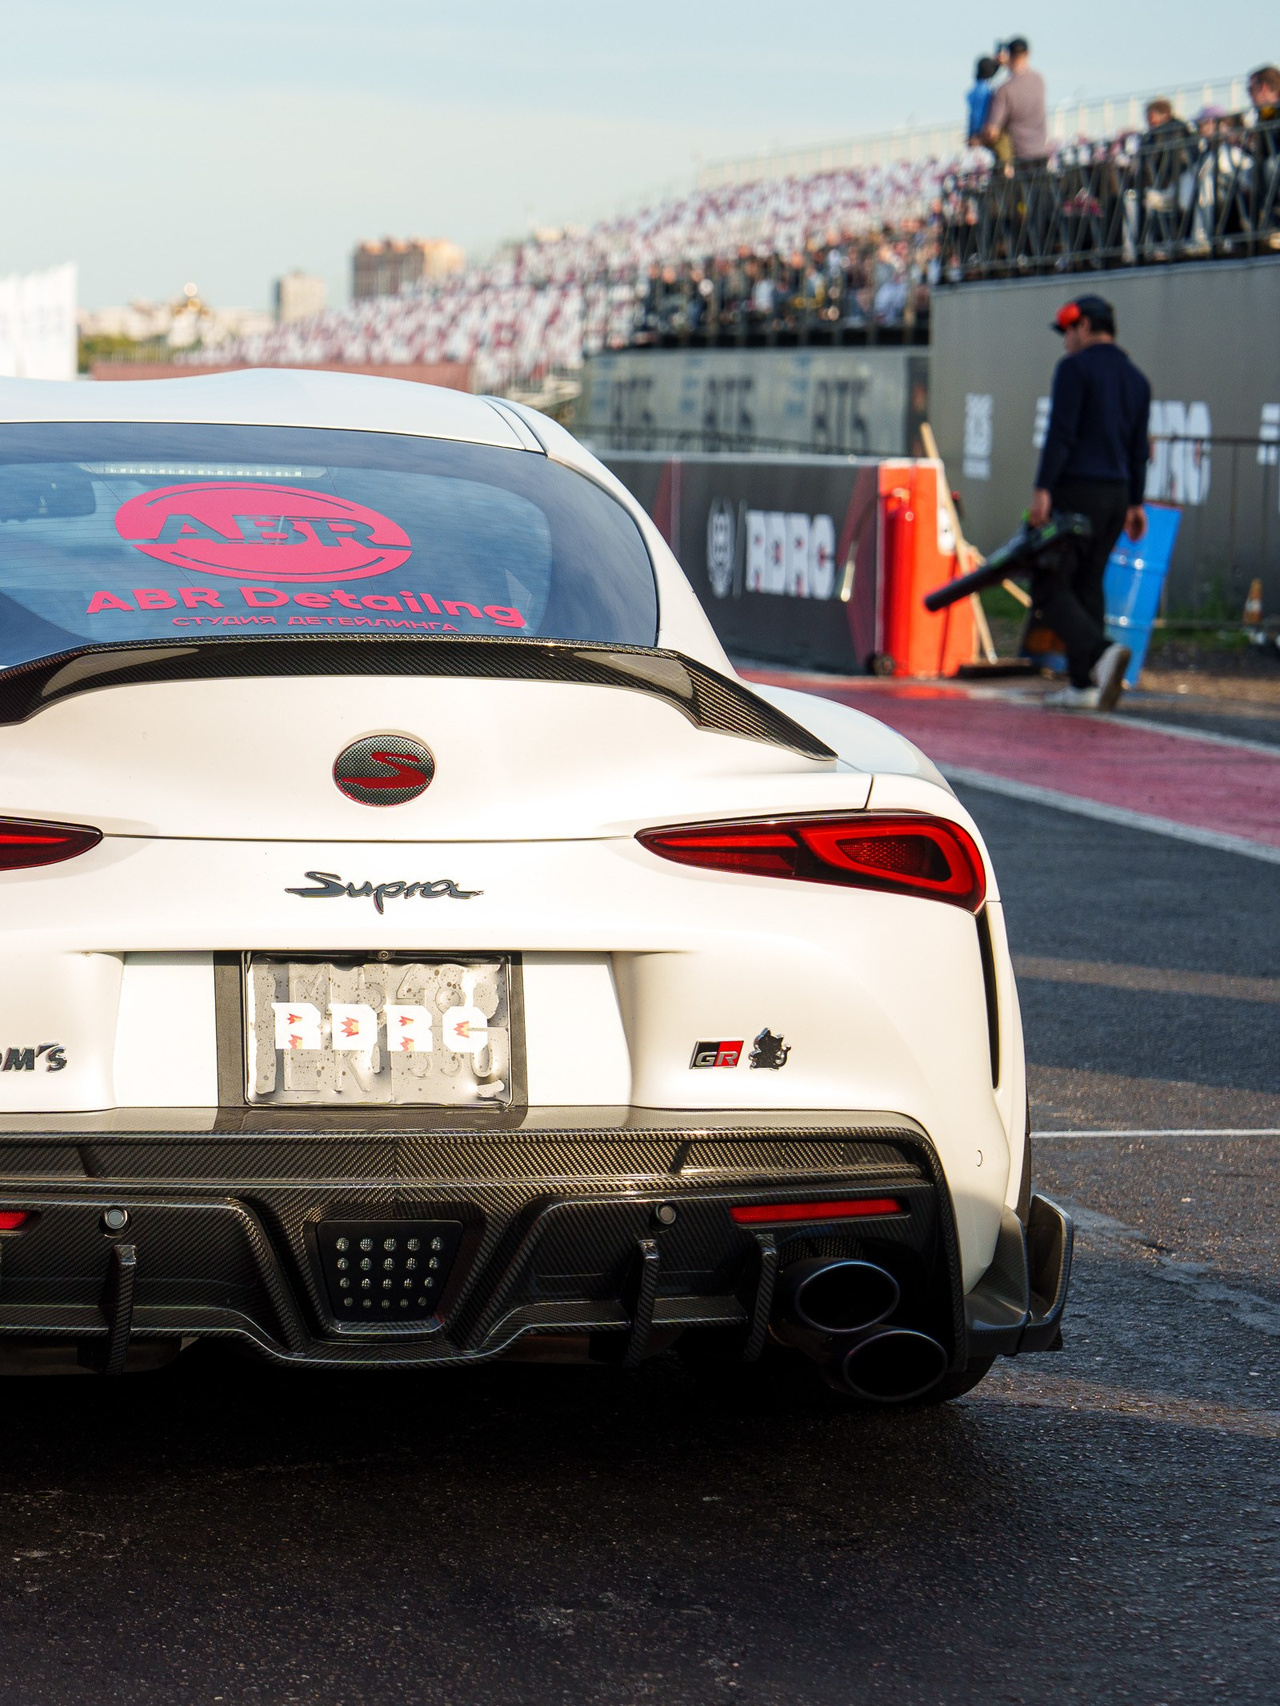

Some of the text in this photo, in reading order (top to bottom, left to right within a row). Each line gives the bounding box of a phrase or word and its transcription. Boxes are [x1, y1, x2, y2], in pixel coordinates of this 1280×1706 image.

[157, 513, 376, 548] ABR
[745, 510, 836, 600] RDRC
[86, 587, 225, 614] ABR
[172, 616, 460, 632] СТУДИЯ ДЕТЕЙЛИНГА
[284, 871, 485, 915] Supra
[271, 1002, 489, 1053] RDRC
[694, 1050, 739, 1067] GR
